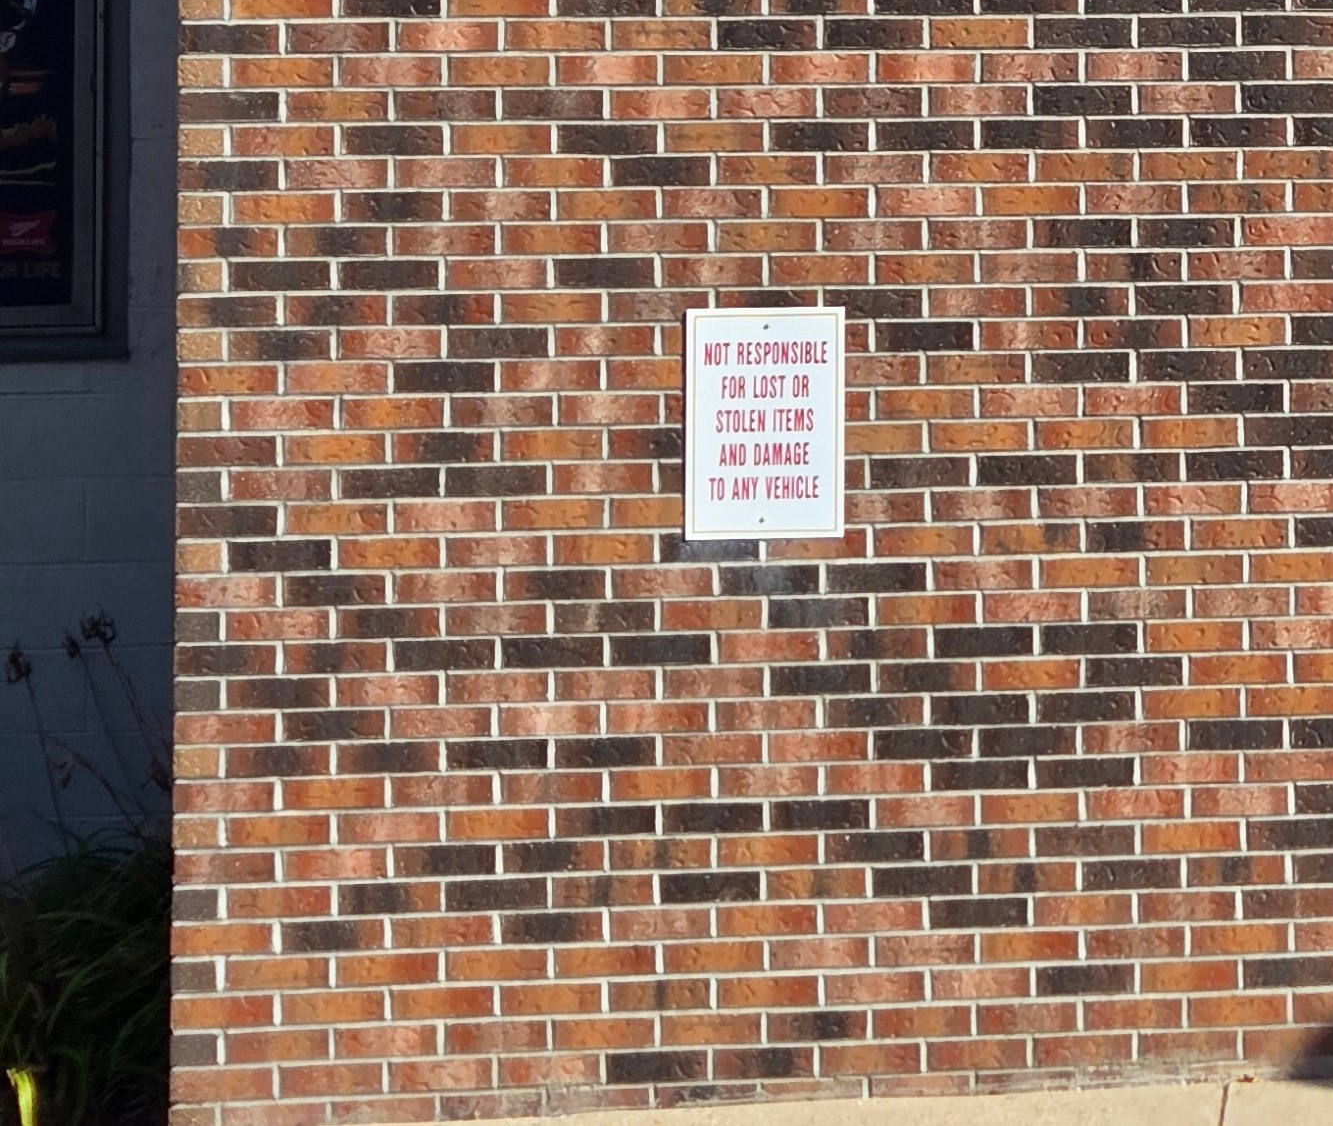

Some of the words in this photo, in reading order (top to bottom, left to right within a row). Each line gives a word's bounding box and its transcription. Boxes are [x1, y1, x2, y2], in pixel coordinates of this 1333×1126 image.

[704, 343, 730, 366] NOT
[737, 341, 828, 365] RESPONSIBLE
[721, 376, 745, 399] FOR
[754, 375, 786, 399] LOST
[793, 375, 809, 398] OR
[716, 409, 766, 433] STOLEN
[773, 408, 814, 432] ITEMS
[719, 443, 746, 467] AND
[754, 442, 810, 466] DAMAGE
[709, 477, 725, 501] TO
[732, 476, 759, 500] ANY
[766, 476, 819, 499] VEHICLE
